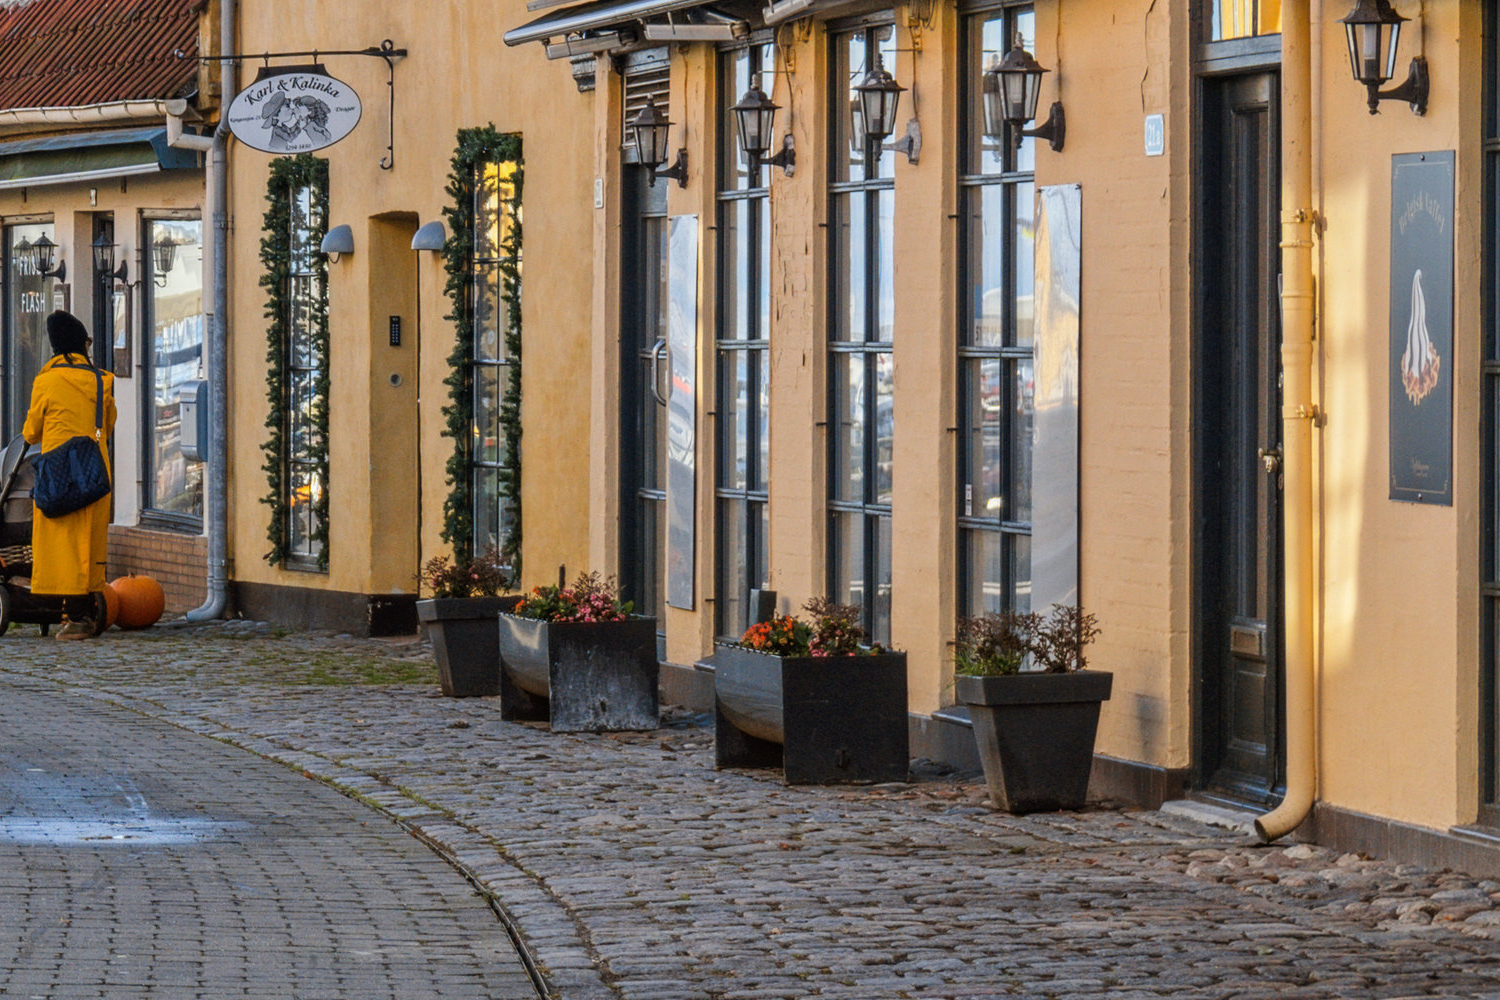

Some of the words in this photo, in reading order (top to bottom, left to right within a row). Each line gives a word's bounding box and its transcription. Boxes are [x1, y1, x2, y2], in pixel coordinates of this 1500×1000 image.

[245, 81, 272, 106] Karl
[277, 80, 289, 92] &
[289, 76, 340, 98] Kalinka
[22, 292, 45, 313] FLASH
